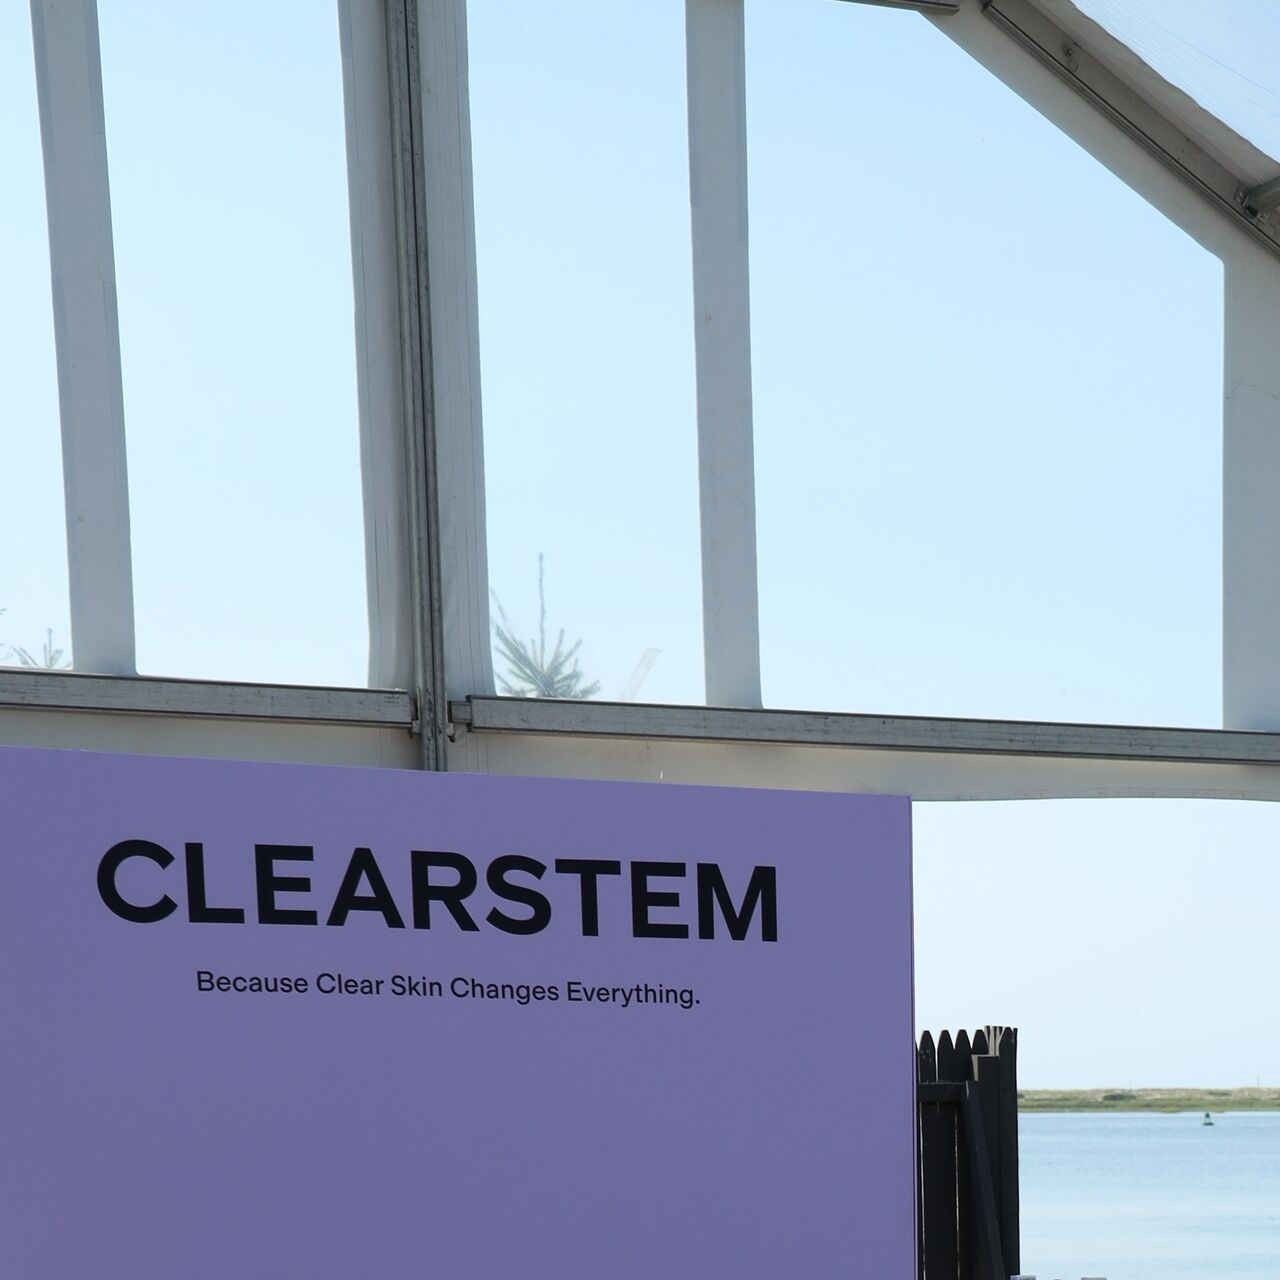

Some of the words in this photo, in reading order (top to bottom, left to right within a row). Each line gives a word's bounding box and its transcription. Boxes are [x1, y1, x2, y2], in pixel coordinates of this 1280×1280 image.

[96, 839, 778, 943] CLEARSTEM
[196, 970, 309, 994] Because
[316, 972, 385, 995] Clear
[391, 975, 443, 997] Skin
[450, 977, 560, 1006] Changes
[567, 981, 700, 1010] Everything.
